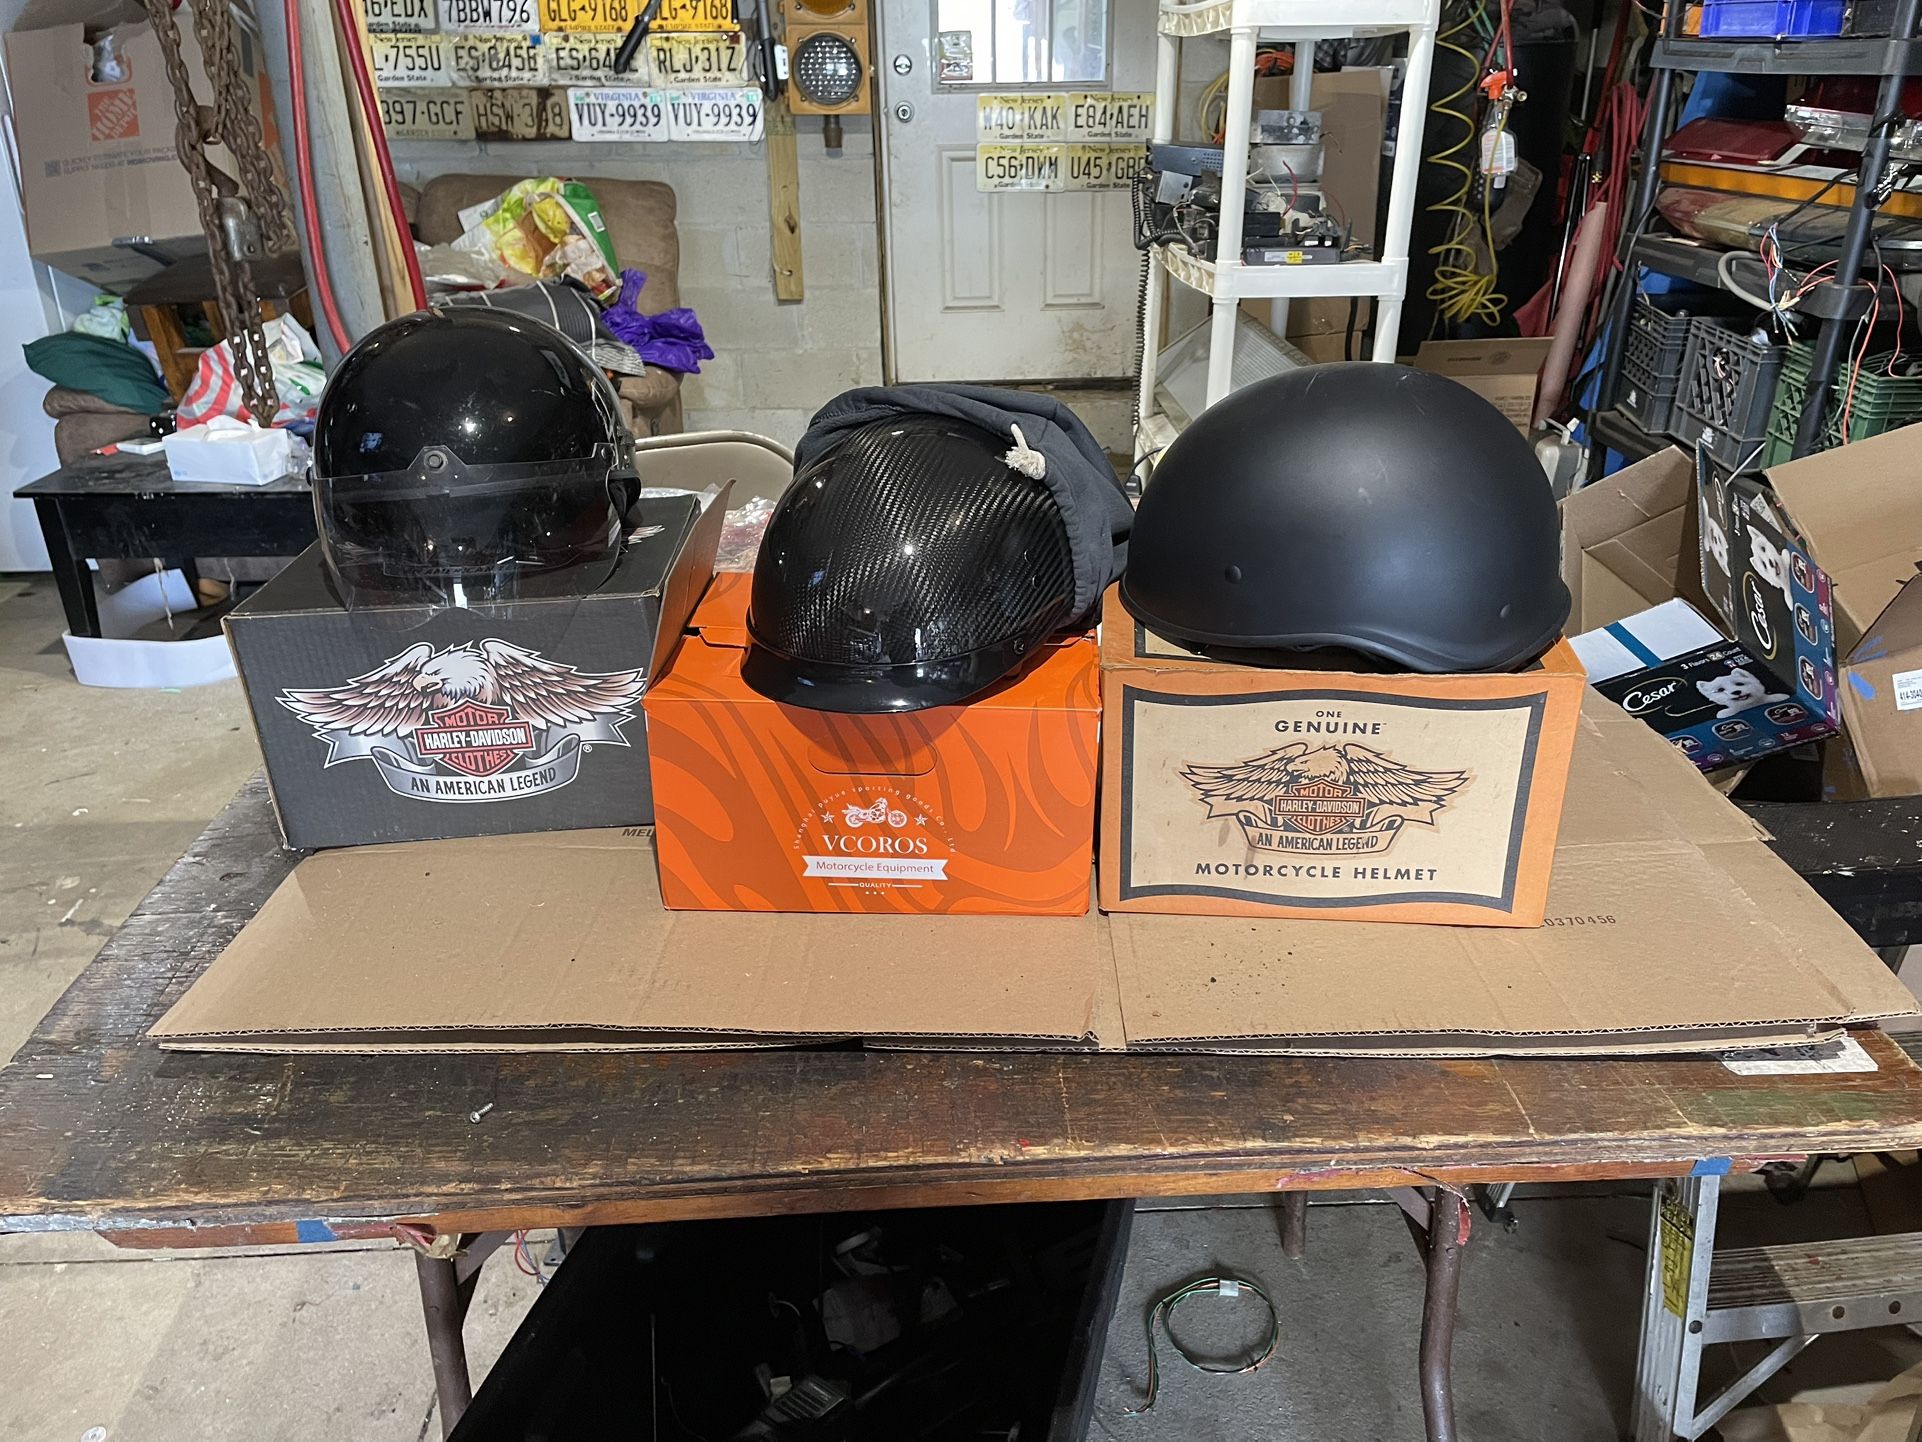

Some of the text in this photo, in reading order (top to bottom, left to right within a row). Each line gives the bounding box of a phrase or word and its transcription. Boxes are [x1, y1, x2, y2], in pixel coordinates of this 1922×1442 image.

[378, 74, 428, 82] Garden State
[593, 92, 640, 101] VIRGINIA
[690, 92, 736, 101] VIRGINIA
[1020, 96, 1044, 105] Jersey
[1090, 94, 1134, 105] New Jersey
[91, 87, 137, 140] HOME
[575, 103, 662, 127] VUY-9939
[671, 103, 757, 127] VUY-9939
[1750, 577, 1772, 650] Cesar
[1622, 680, 1677, 712] Cesar
[444, 707, 499, 727] MOTOR
[1316, 710, 1343, 719] ONE
[1274, 720, 1382, 736] GENUINE
[424, 727, 527, 750] HARLEY-DAVIDSON
[451, 750, 506, 772] CLOTHES
[411, 766, 557, 796] AN AMERICAN LEGEND
[1300, 784, 1343, 797] MOTOR
[1280, 800, 1360, 814] HARLEY-DAVIDSON
[1299, 816, 1341, 832] CLOTHES
[821, 834, 928, 854] VCOROS
[1257, 832, 1379, 851] AN AMERICAN LEGEND
[816, 860, 934, 874] Motorcycle Equipment
[1194, 863, 1439, 881] MOTORCYCLE HELMET
[1542, 915, 1617, 927] 0370456
